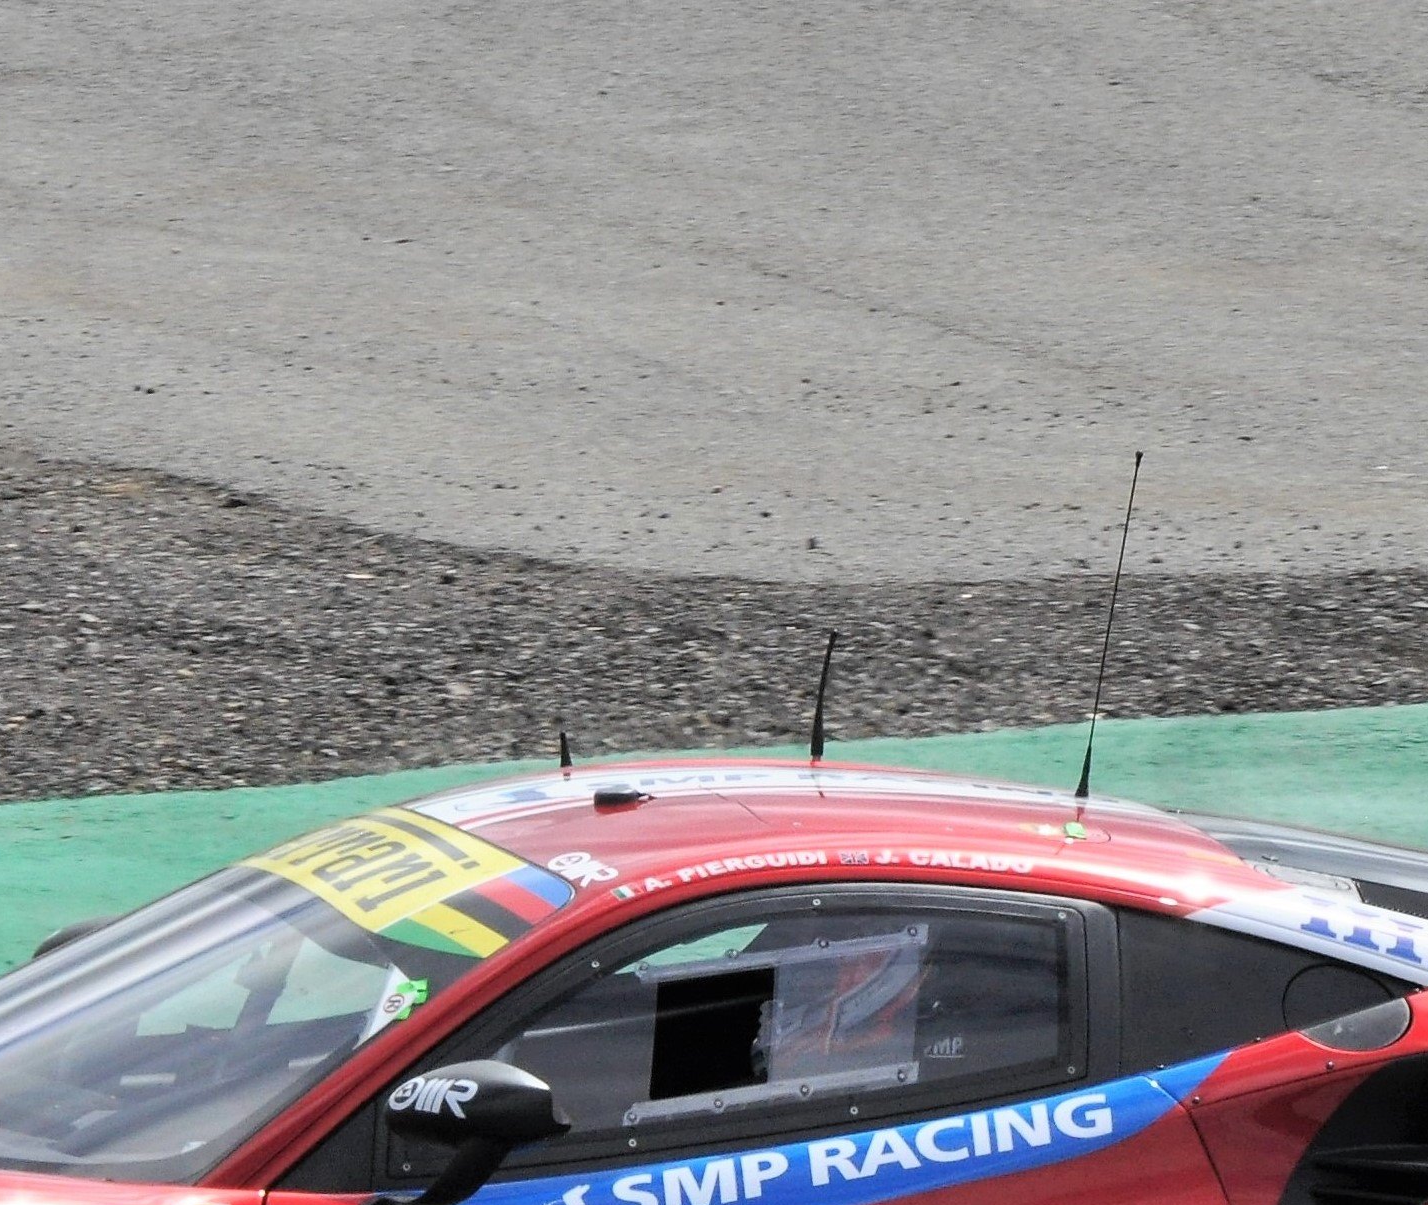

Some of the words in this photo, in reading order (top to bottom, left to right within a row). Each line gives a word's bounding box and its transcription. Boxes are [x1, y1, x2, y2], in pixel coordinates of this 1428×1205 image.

[644, 876, 673, 891] A.
[676, 851, 829, 884] PIERGUIDI
[875, 849, 900, 864] J.
[908, 850, 1034, 874] CALADO
[808, 1093, 1115, 1188] RACING
